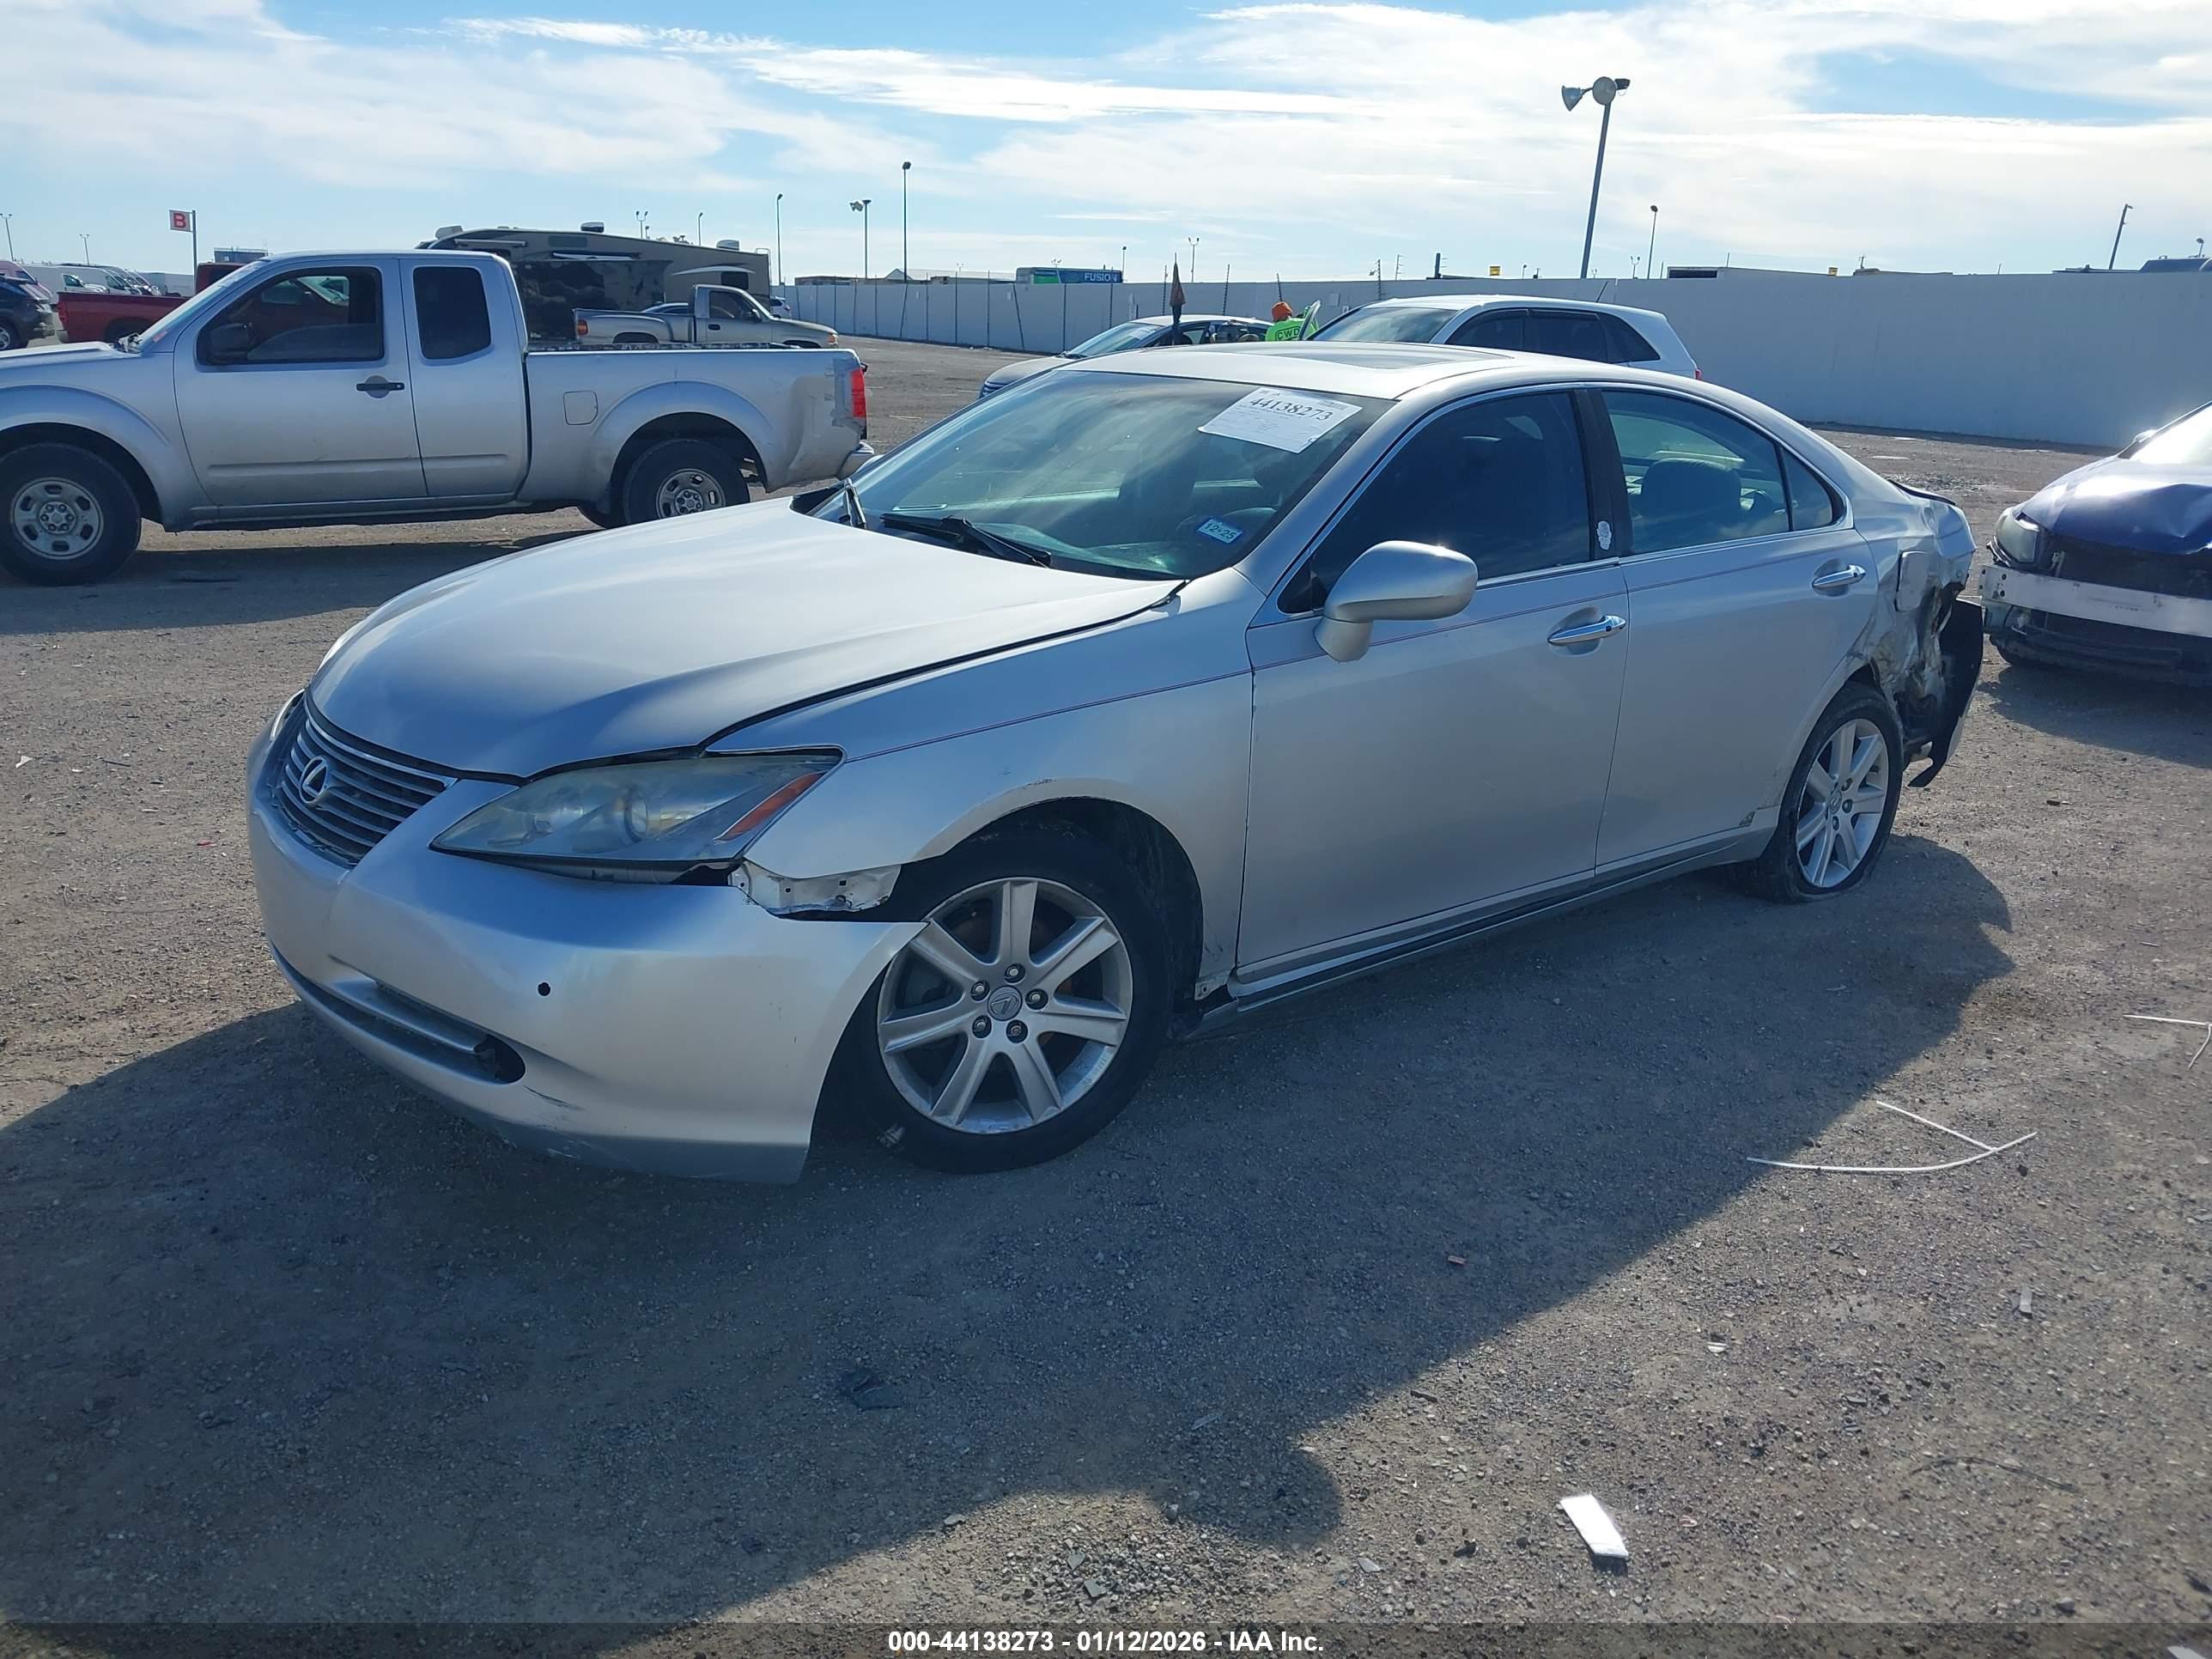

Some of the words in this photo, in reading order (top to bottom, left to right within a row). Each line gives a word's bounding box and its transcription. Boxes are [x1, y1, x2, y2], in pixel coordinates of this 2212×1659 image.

[173, 212, 186, 228] B
[1085, 272, 1118, 283] FUSION
[1249, 398, 1334, 421] 44138273
